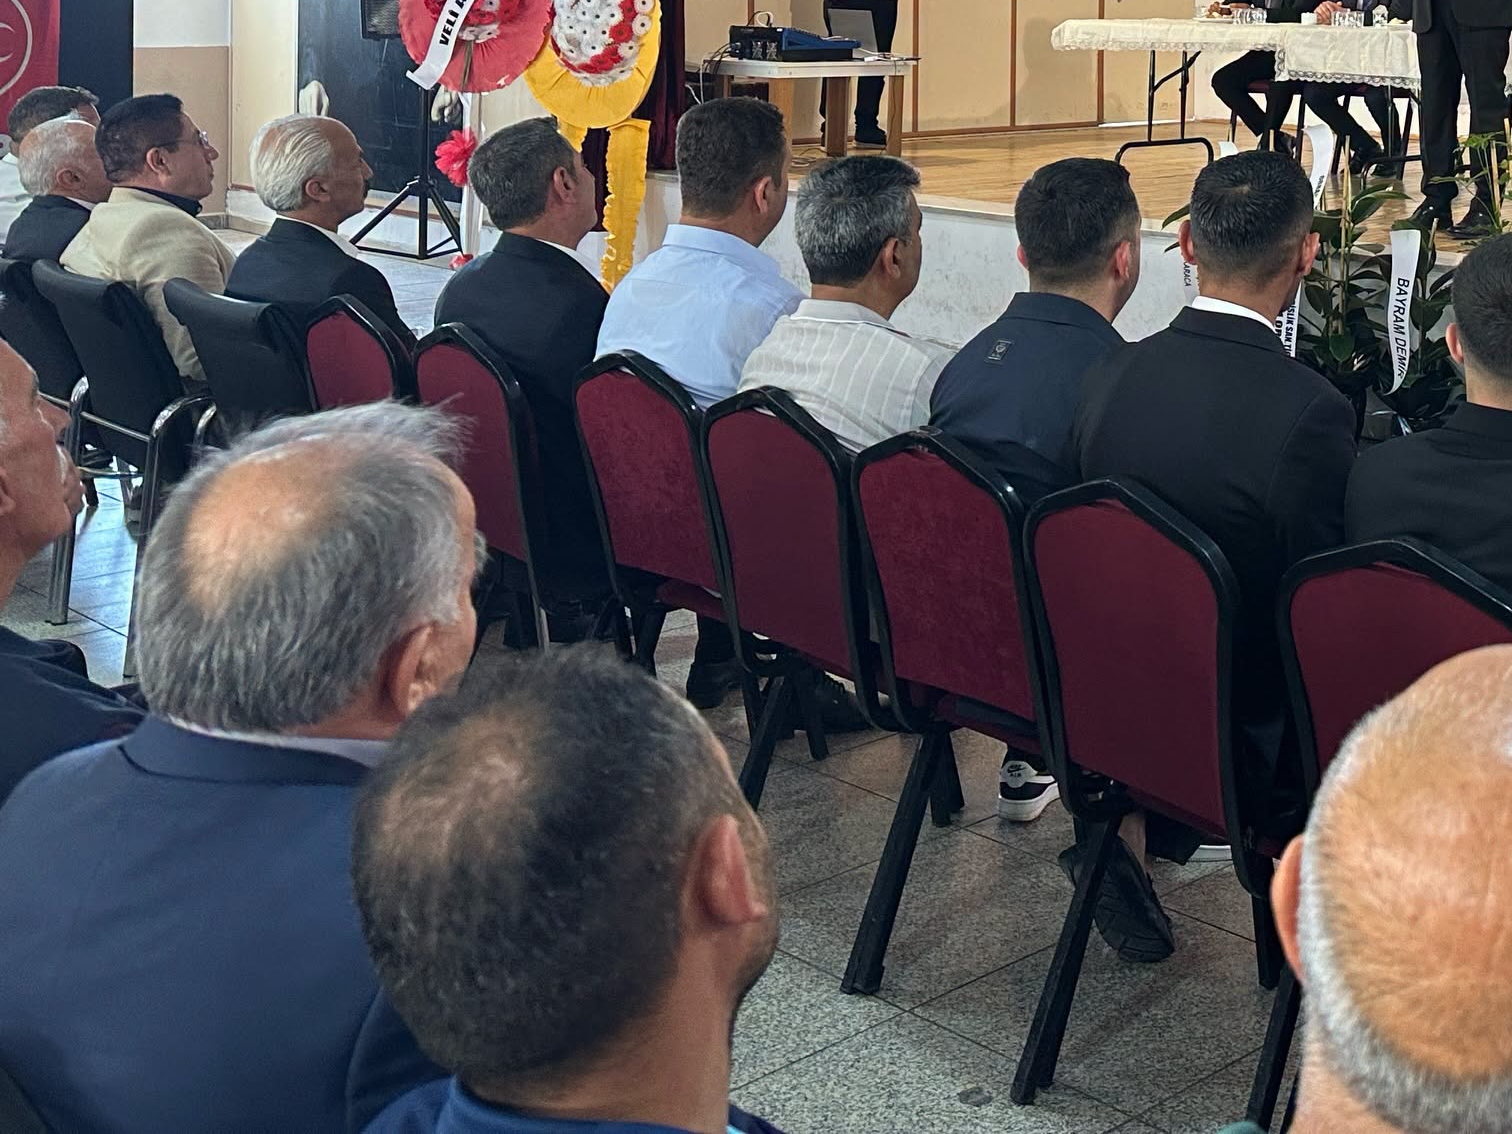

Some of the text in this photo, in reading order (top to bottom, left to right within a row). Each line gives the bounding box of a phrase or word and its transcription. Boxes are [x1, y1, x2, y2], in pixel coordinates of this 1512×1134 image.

[439, 9, 460, 45] VELİ
[1393, 277, 1410, 378] BAYRAM DEMİR
